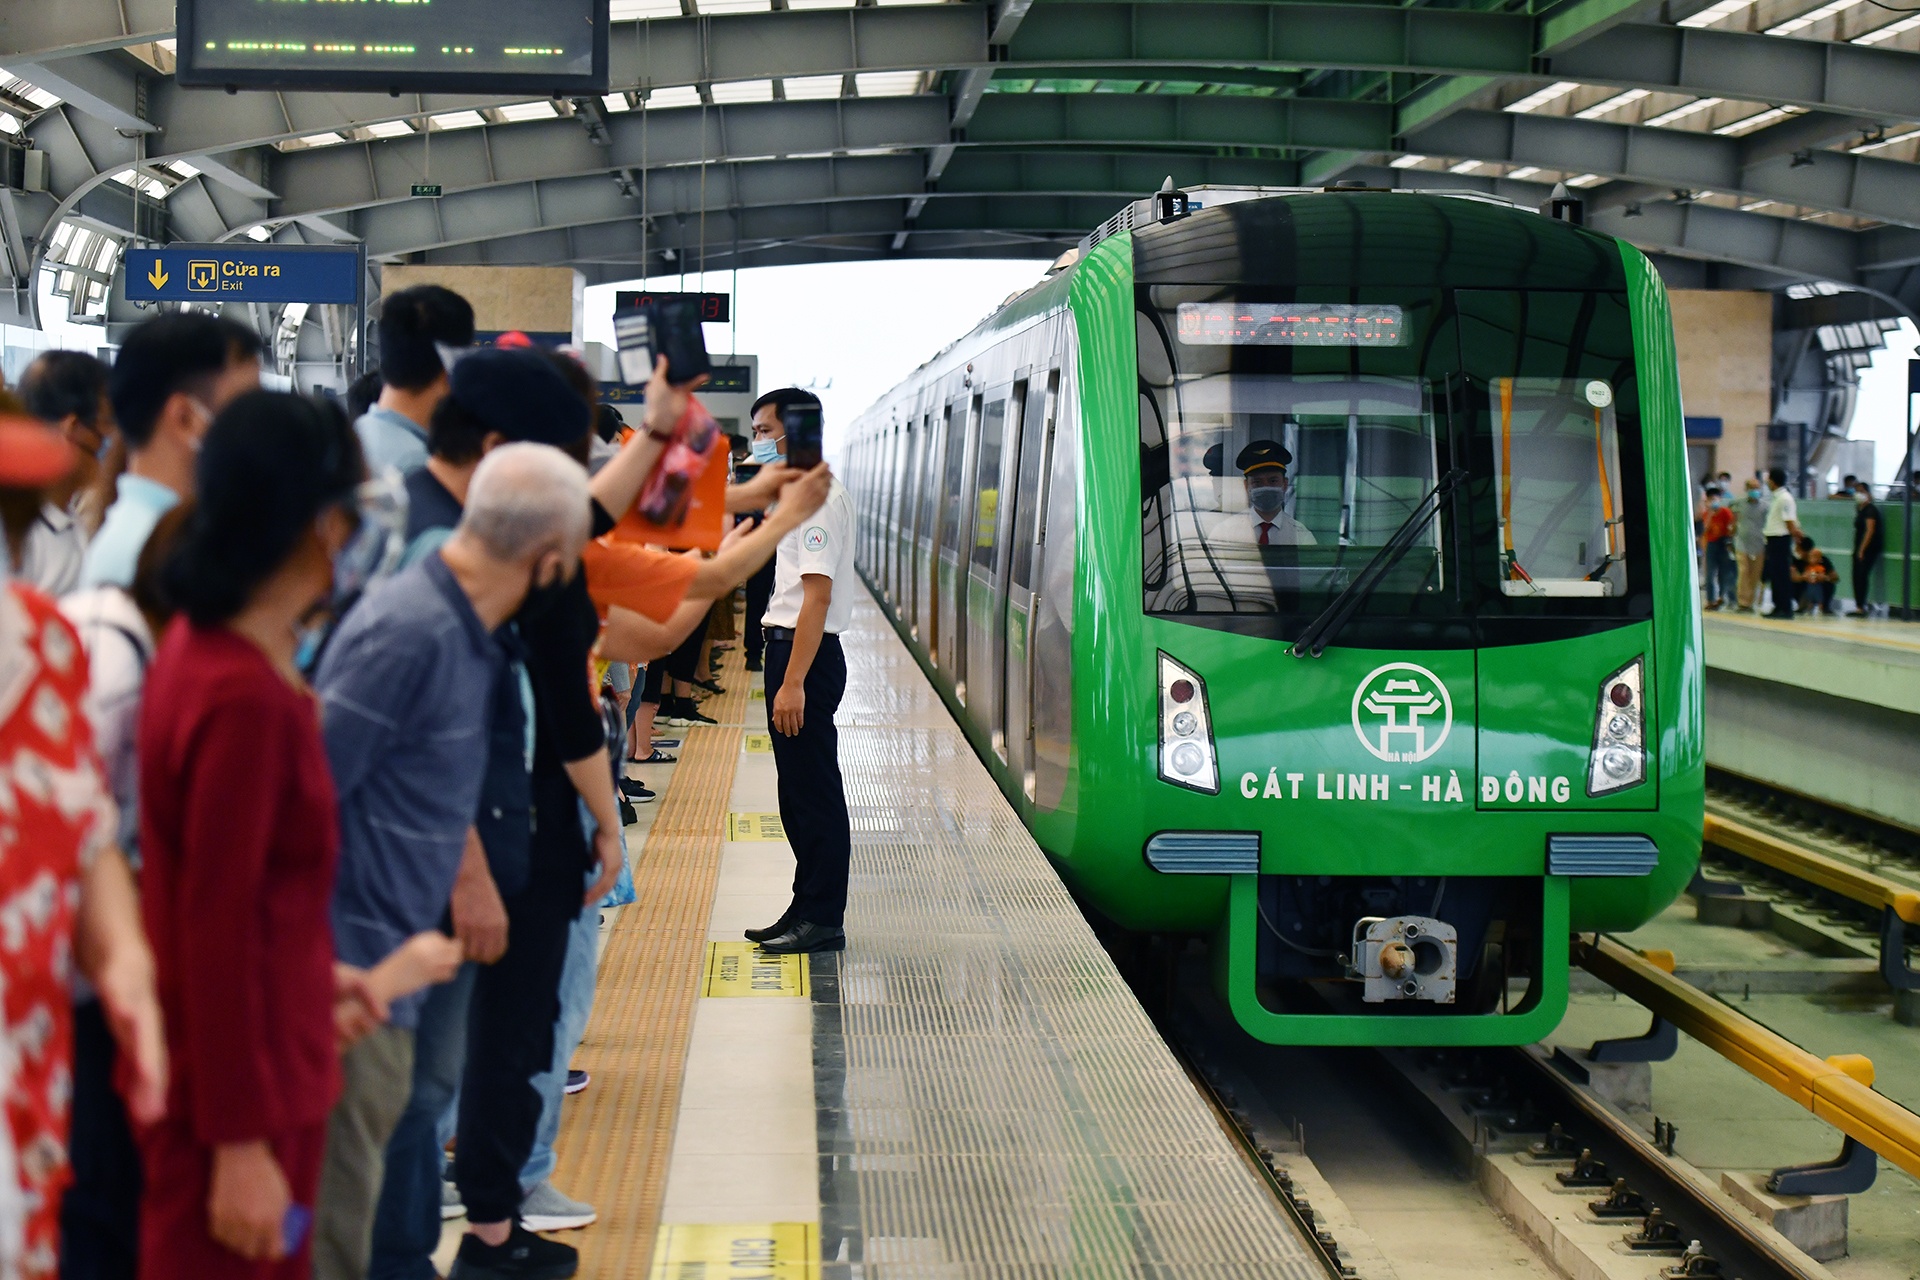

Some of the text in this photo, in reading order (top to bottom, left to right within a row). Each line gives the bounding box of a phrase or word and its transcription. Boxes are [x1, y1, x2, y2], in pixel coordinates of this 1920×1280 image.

[222, 260, 280, 277] Cửa ra
[222, 280, 243, 290] Exit
[1401, 750, 1418, 764] NỘI
[1240, 766, 1304, 800] CÁT
[1317, 773, 1390, 801] LINH
[1422, 770, 1464, 803] HÀ
[1481, 770, 1571, 804] ĐÔNG
[730, 1238, 787, 1268] CHÚ
